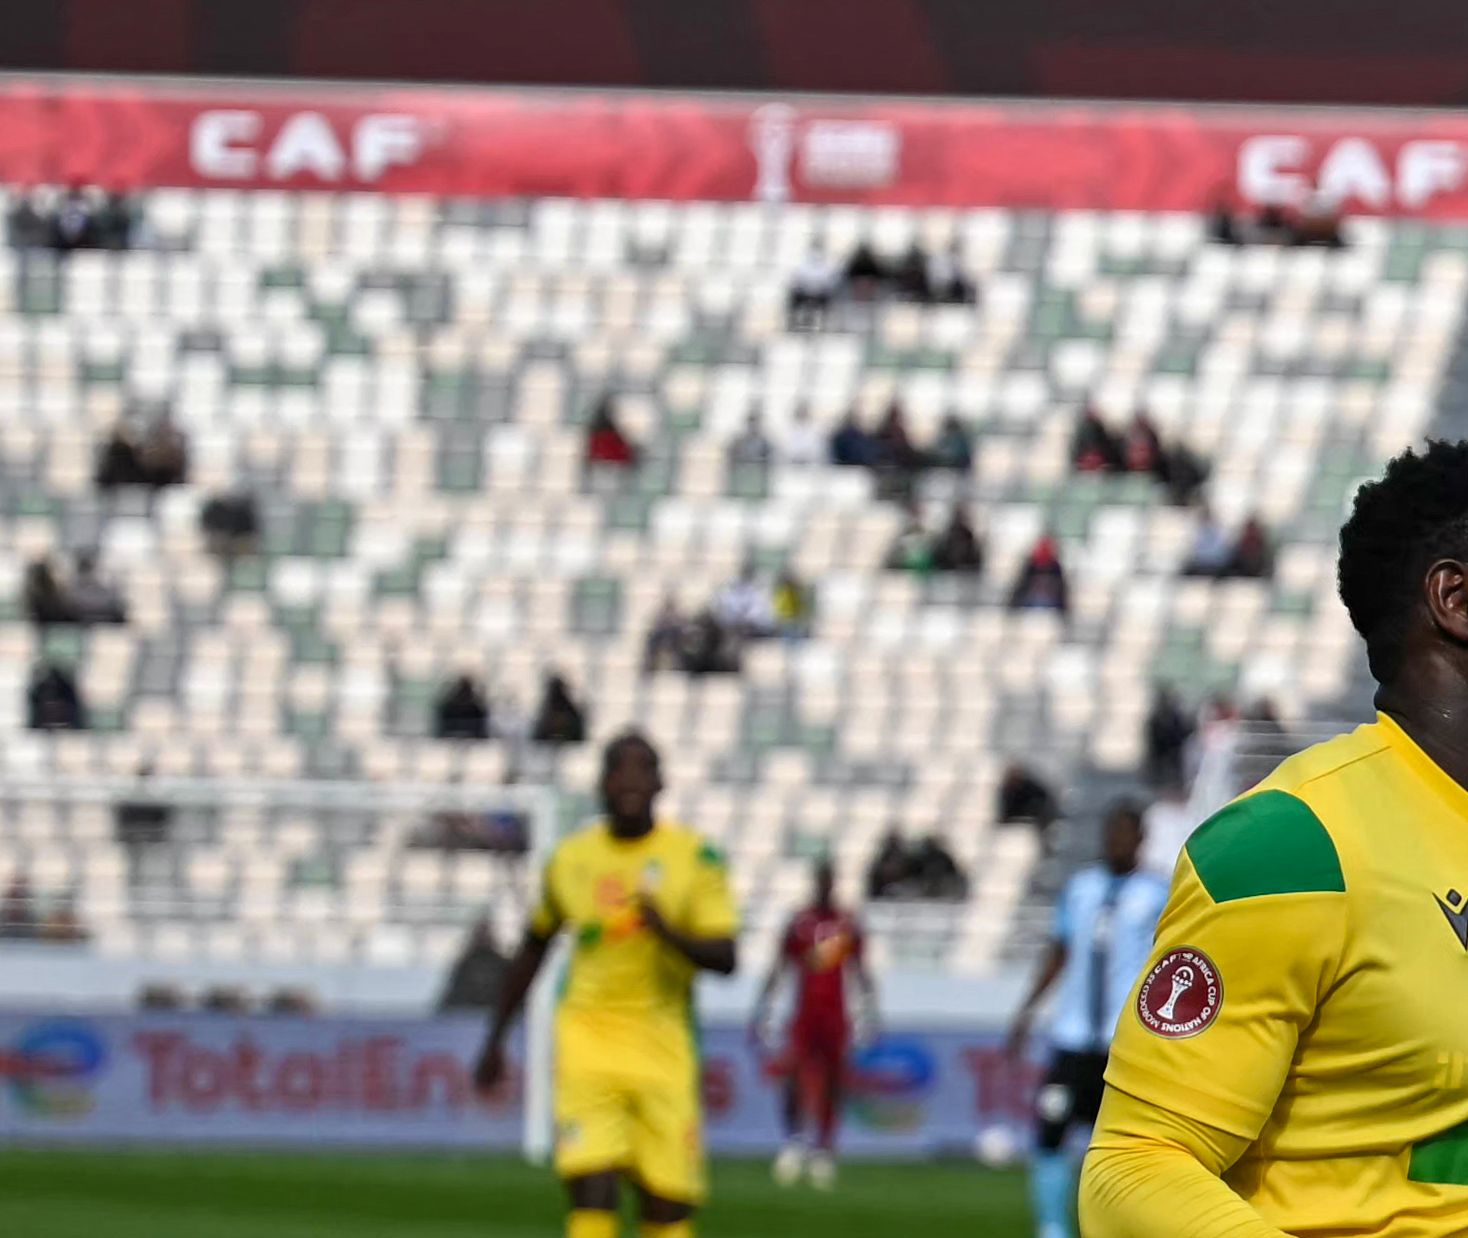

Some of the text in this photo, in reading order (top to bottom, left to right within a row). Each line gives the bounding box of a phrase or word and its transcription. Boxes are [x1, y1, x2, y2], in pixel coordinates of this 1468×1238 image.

[190, 109, 421, 182] CAF
[1237, 134, 1468, 210] CAF
[1191, 956, 1215, 986] AFRICA
[1207, 985, 1217, 1007] CUP
[1161, 1016, 1202, 1033] NATIONS
[1200, 1006, 1211, 1021] OF
